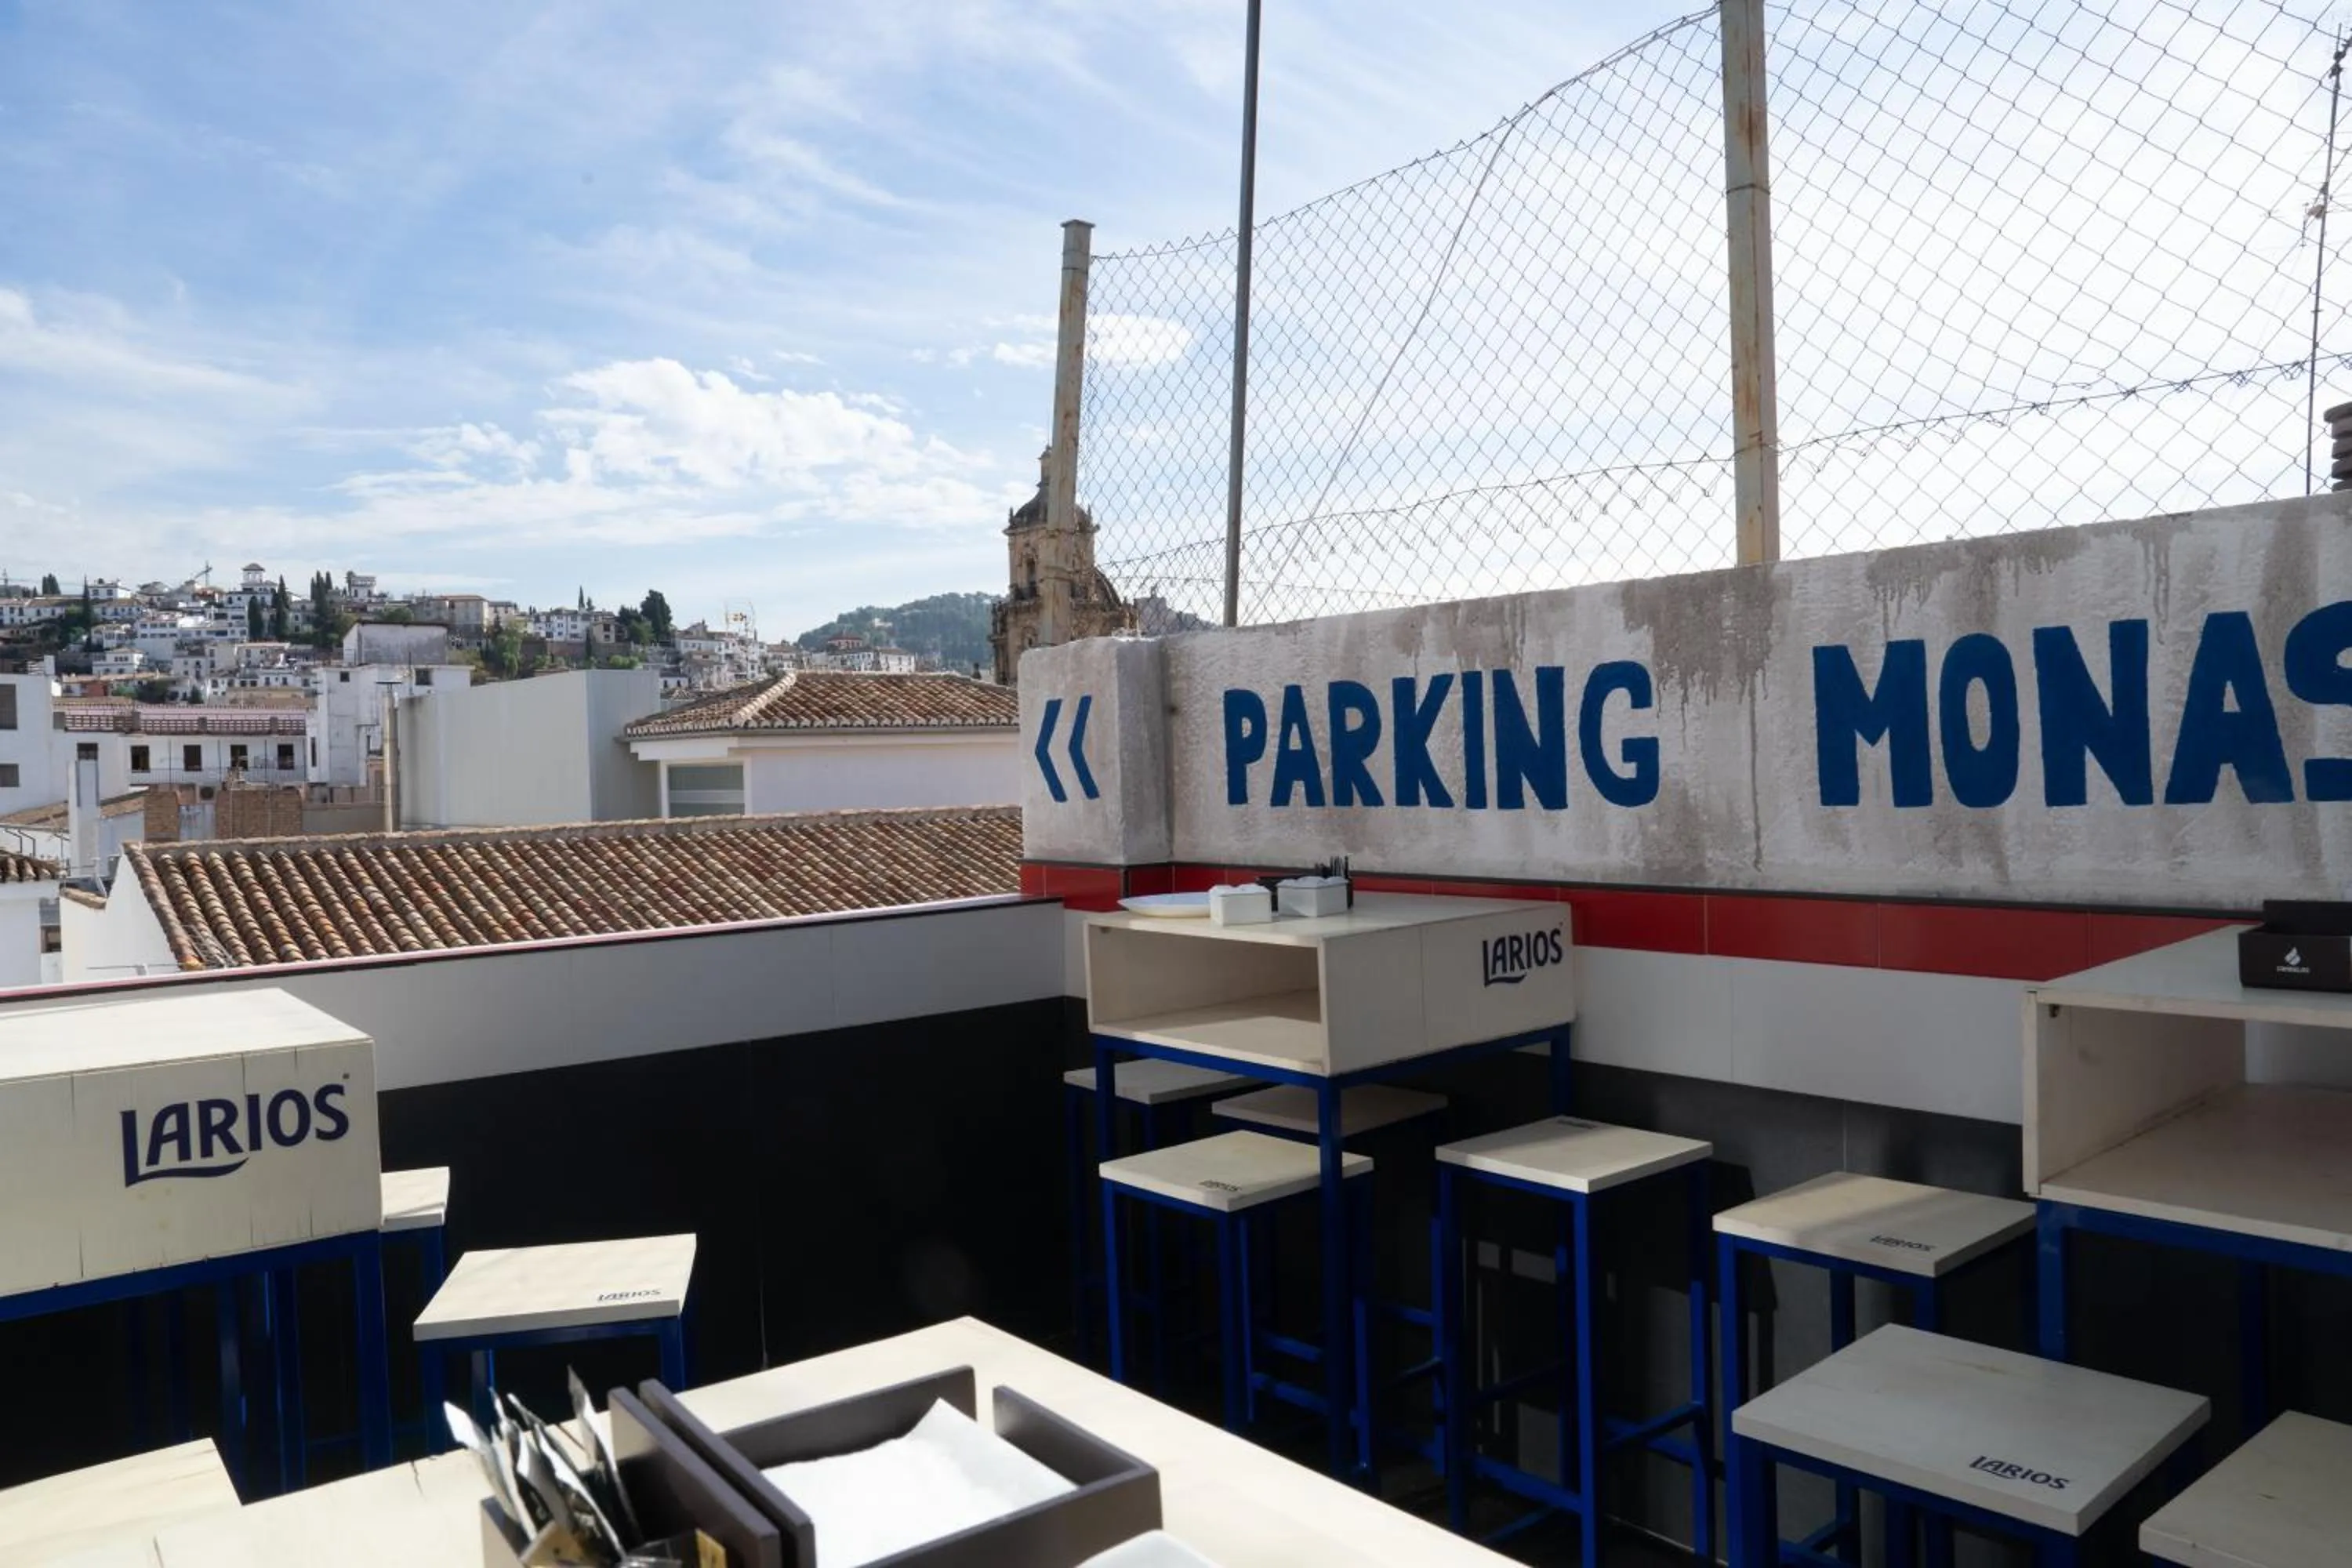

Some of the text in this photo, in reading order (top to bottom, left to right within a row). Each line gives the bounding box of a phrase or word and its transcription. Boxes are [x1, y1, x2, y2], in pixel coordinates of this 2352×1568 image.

[1222, 660, 1660, 810] PARKING
[1482, 927, 1563, 989] LARIOS
[120, 1083, 350, 1188] LARIOS
[1969, 1455, 2071, 1490] LARIOS
